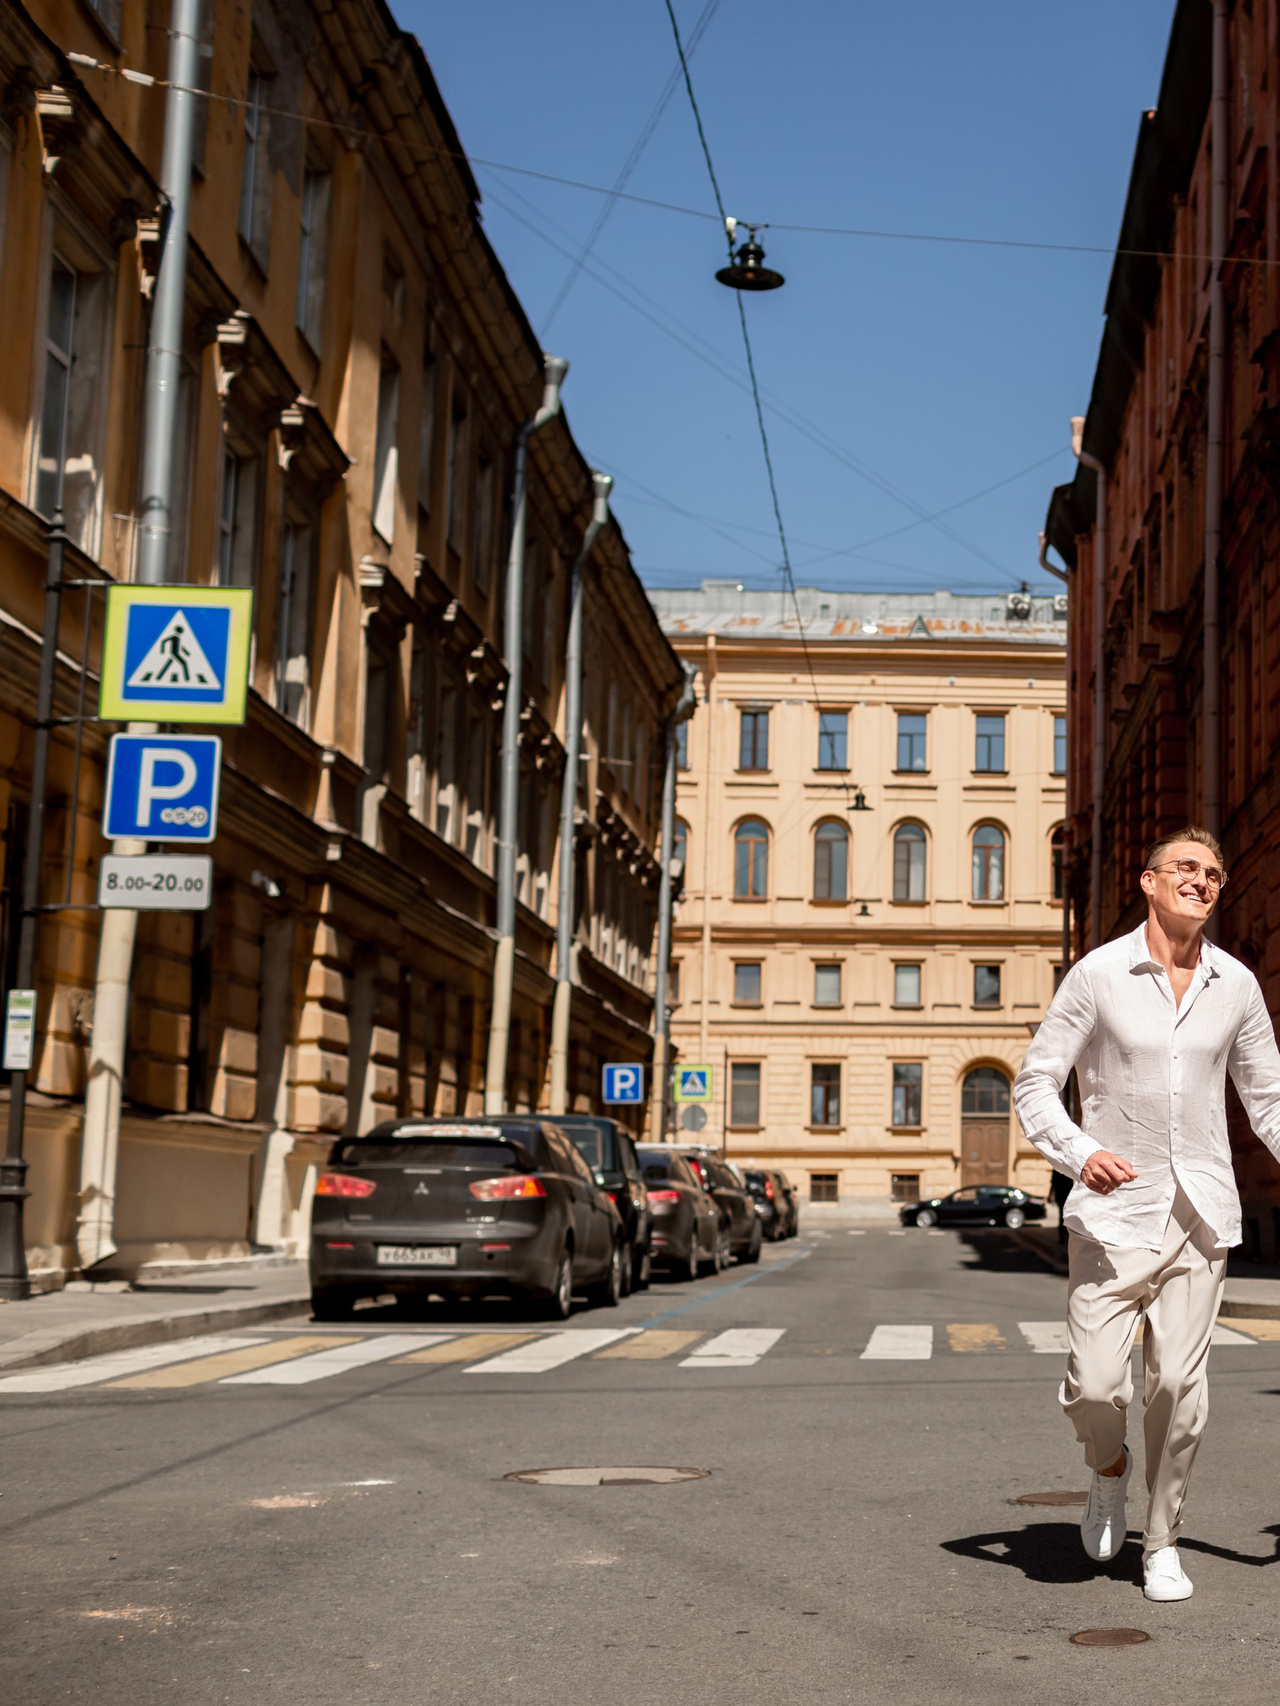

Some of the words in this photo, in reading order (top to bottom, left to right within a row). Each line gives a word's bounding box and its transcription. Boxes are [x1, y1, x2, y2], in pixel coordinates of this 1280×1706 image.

[136, 747, 198, 828] P
[106, 872, 204, 892] 8.00-20.00
[613, 1069, 636, 1099] P
